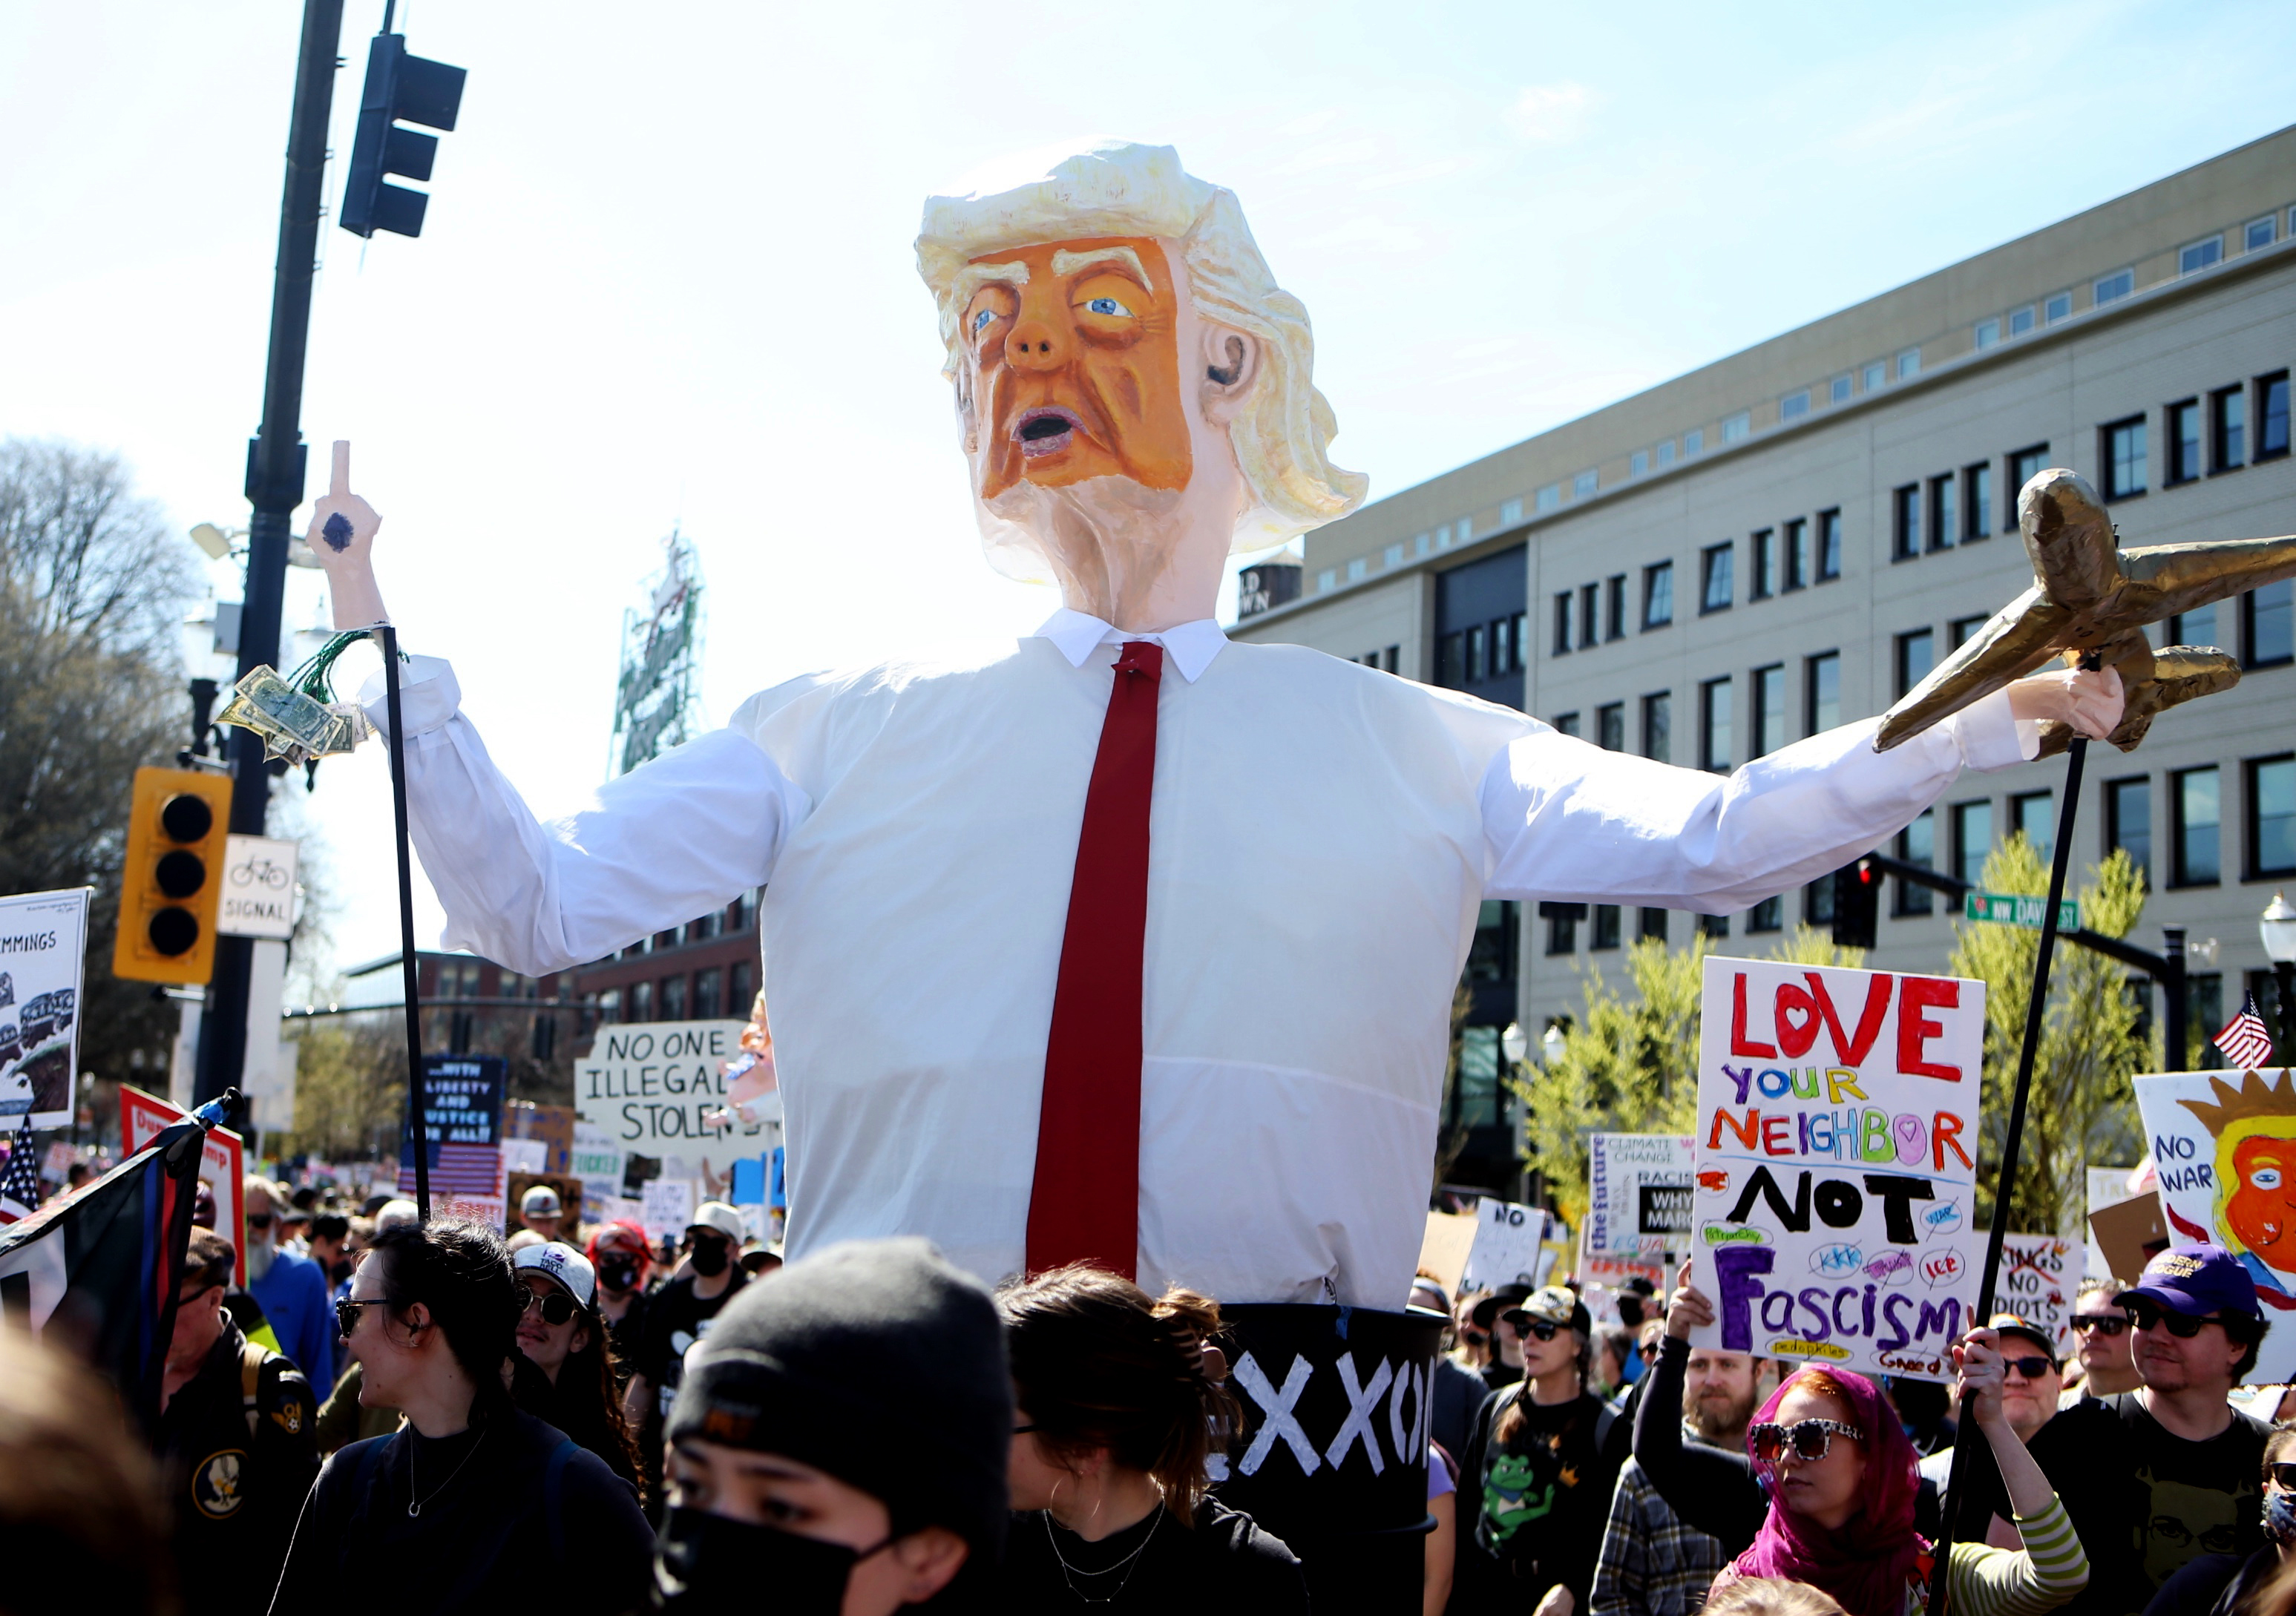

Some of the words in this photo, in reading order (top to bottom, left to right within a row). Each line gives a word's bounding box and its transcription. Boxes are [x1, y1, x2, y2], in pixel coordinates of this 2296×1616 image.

[226, 899, 285, 921] SIGNAL
[1993, 901, 2013, 922] NW
[2016, 899, 2047, 927] DAV
[2062, 907, 2075, 927] ST
[0, 930, 56, 954] MMINGS
[1731, 972, 1963, 1083] LOVE
[608, 1033, 655, 1062] NO
[663, 1030, 726, 1058] ONE
[424, 1080, 491, 1095] LIBERTY
[586, 1064, 729, 1100] ILLEGAL
[1721, 1062, 1869, 1105] YOUR
[436, 1095, 470, 1109] AND
[424, 1110, 490, 1125] USTICE
[1707, 1107, 1974, 1172] NEIGHBOR
[2155, 1133, 2196, 1164] NO
[1639, 1171, 1694, 1185] RACIS
[2159, 1164, 2213, 1192] WAR
[1651, 1190, 1693, 1209] WHY
[1726, 1165, 1935, 1244] NOT
[1495, 1203, 1525, 1226] NO
[1647, 1209, 1693, 1229] MARC
[1926, 1204, 1960, 1225] WAR
[1612, 1235, 1693, 1252] EQUALIT
[540, 1258, 562, 1270] TACO
[1819, 1246, 1861, 1272] KKK
[2007, 1271, 2039, 1295] NO
[1995, 1295, 2059, 1322] DIOTS
